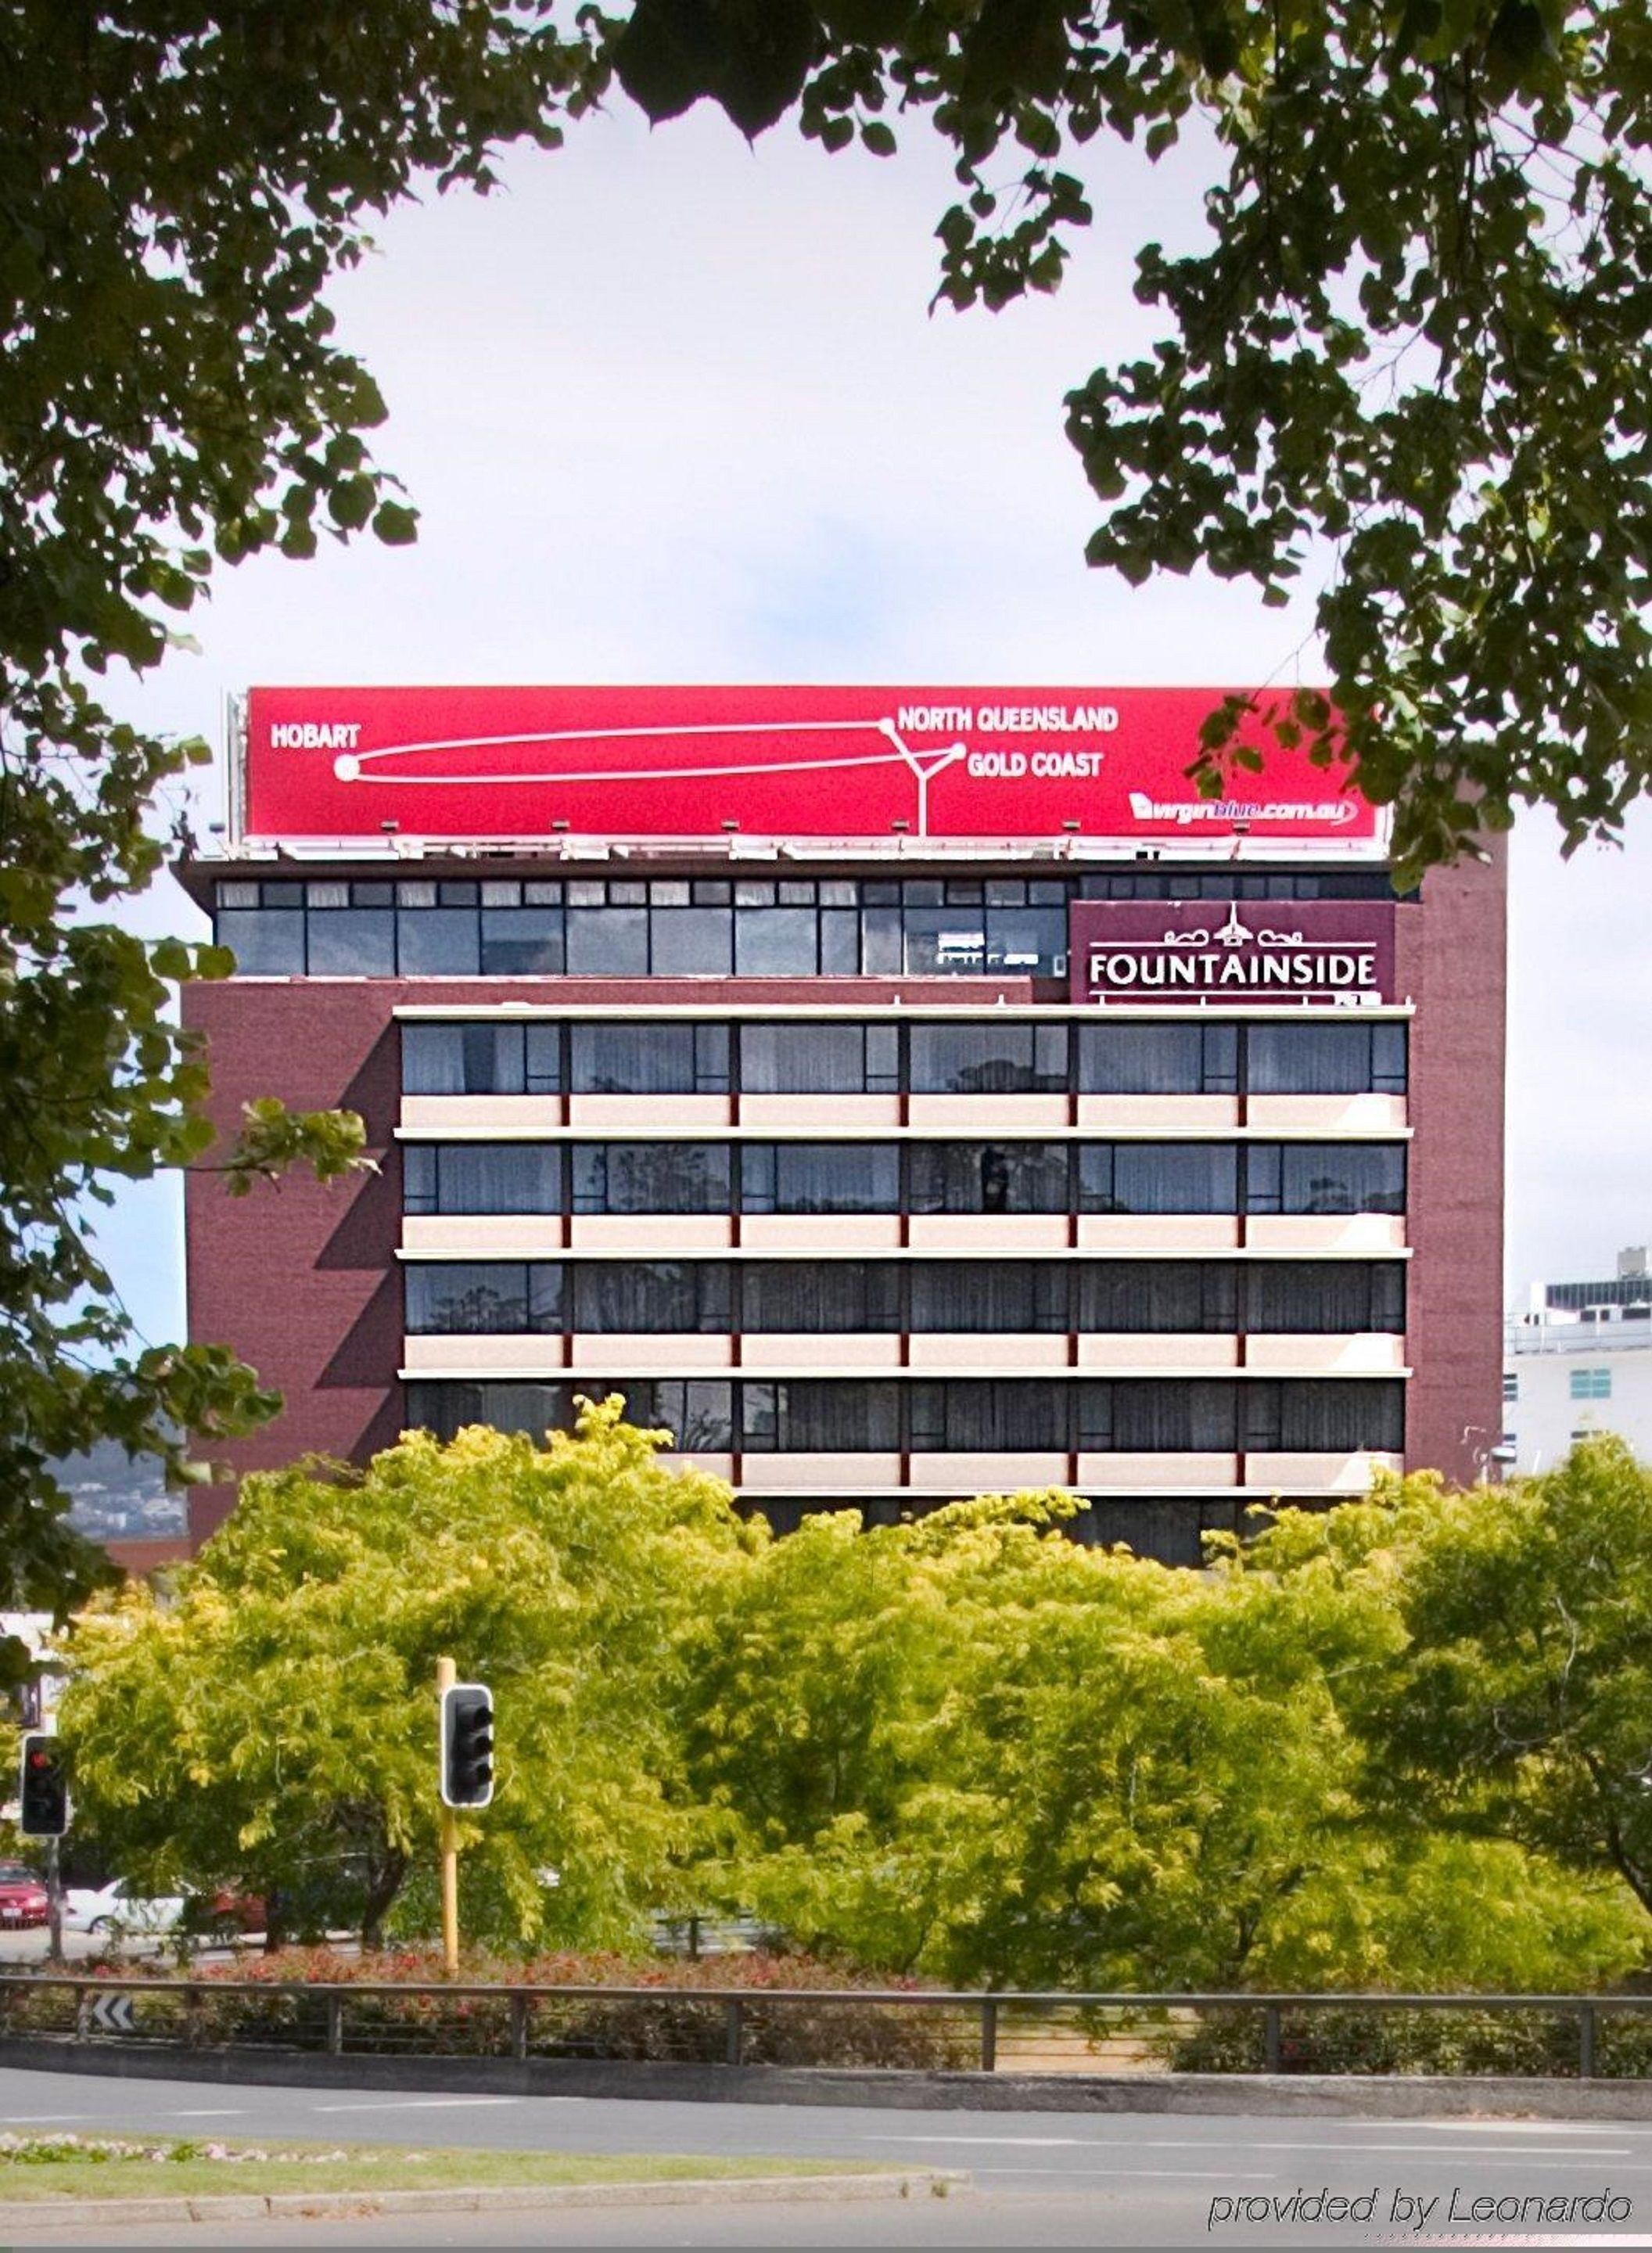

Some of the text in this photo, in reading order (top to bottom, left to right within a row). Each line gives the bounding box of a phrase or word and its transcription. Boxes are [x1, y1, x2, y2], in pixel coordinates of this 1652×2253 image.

[899, 706, 1119, 731] NORTH QUEENSLAND
[271, 723, 361, 749] HOBART
[968, 753, 1103, 777] GOLD COAST
[1090, 954, 1377, 985] FOUNTAINSIDE
